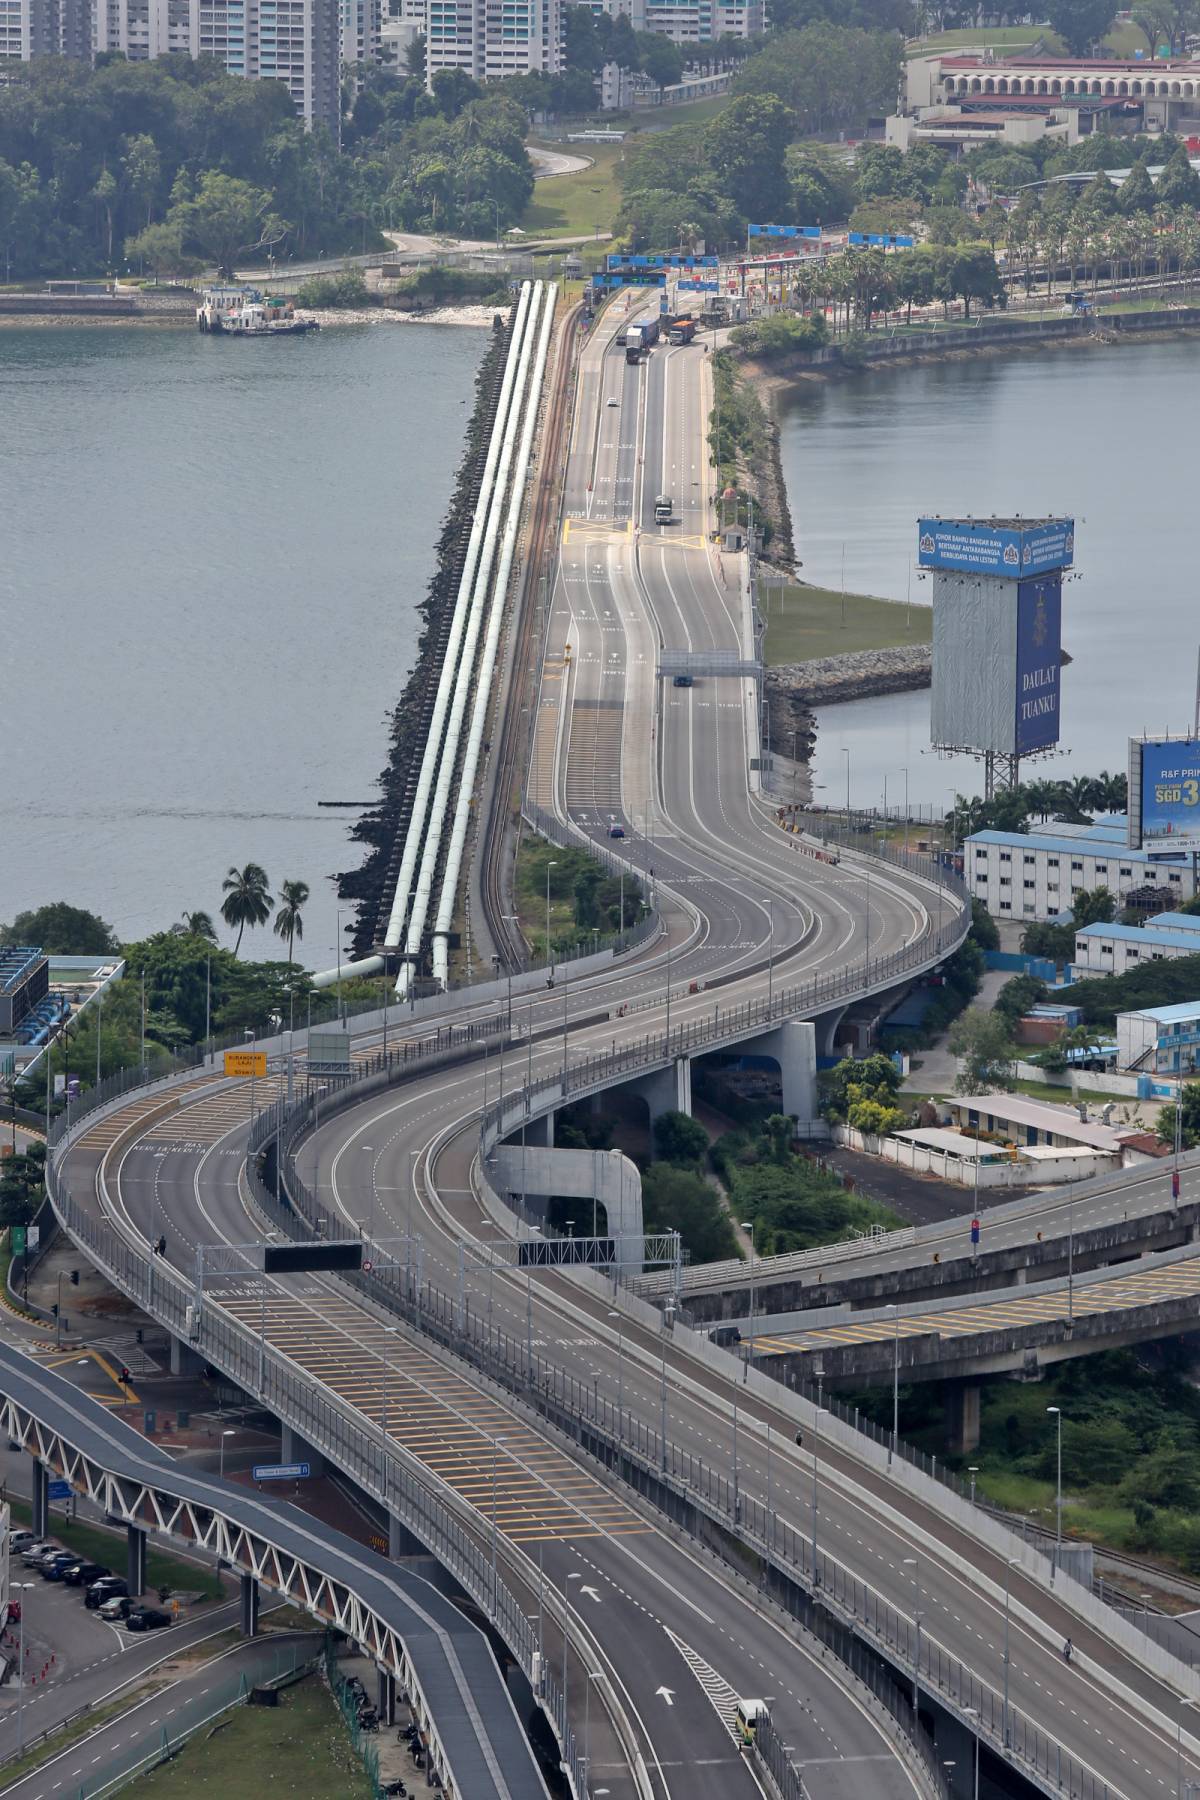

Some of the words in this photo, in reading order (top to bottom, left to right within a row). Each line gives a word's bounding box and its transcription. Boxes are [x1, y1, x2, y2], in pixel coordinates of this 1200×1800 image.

[1023, 665, 1056, 691] DAULAT
[1022, 693, 1056, 720] TUANKU
[1161, 769, 1180, 779] R&F
[1155, 789, 1181, 804] SGD
